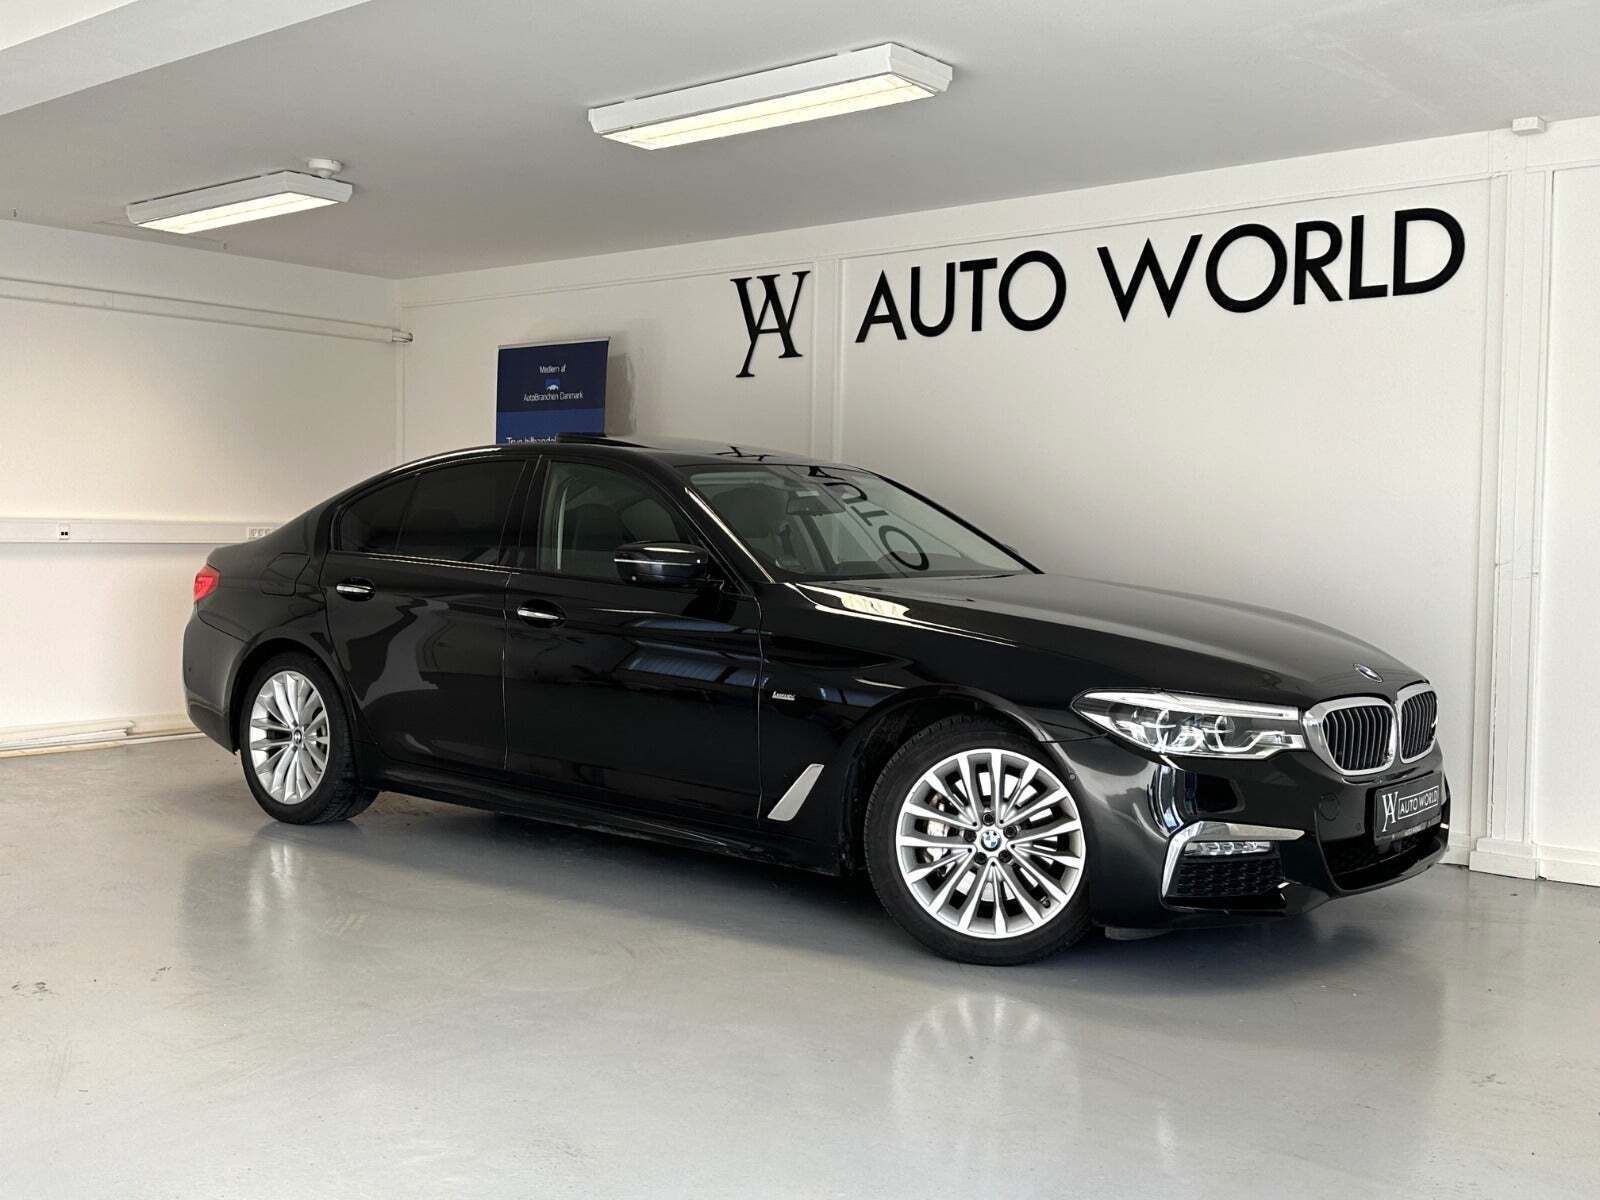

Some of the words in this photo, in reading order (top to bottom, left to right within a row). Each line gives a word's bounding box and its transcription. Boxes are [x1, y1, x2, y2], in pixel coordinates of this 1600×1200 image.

[855, 250, 1067, 344] AUTO
[1096, 207, 1466, 323] WORLD
[559, 391, 584, 401] Danmark
[1400, 798, 1419, 815] AUTO
[1419, 790, 1438, 807] WORLD
